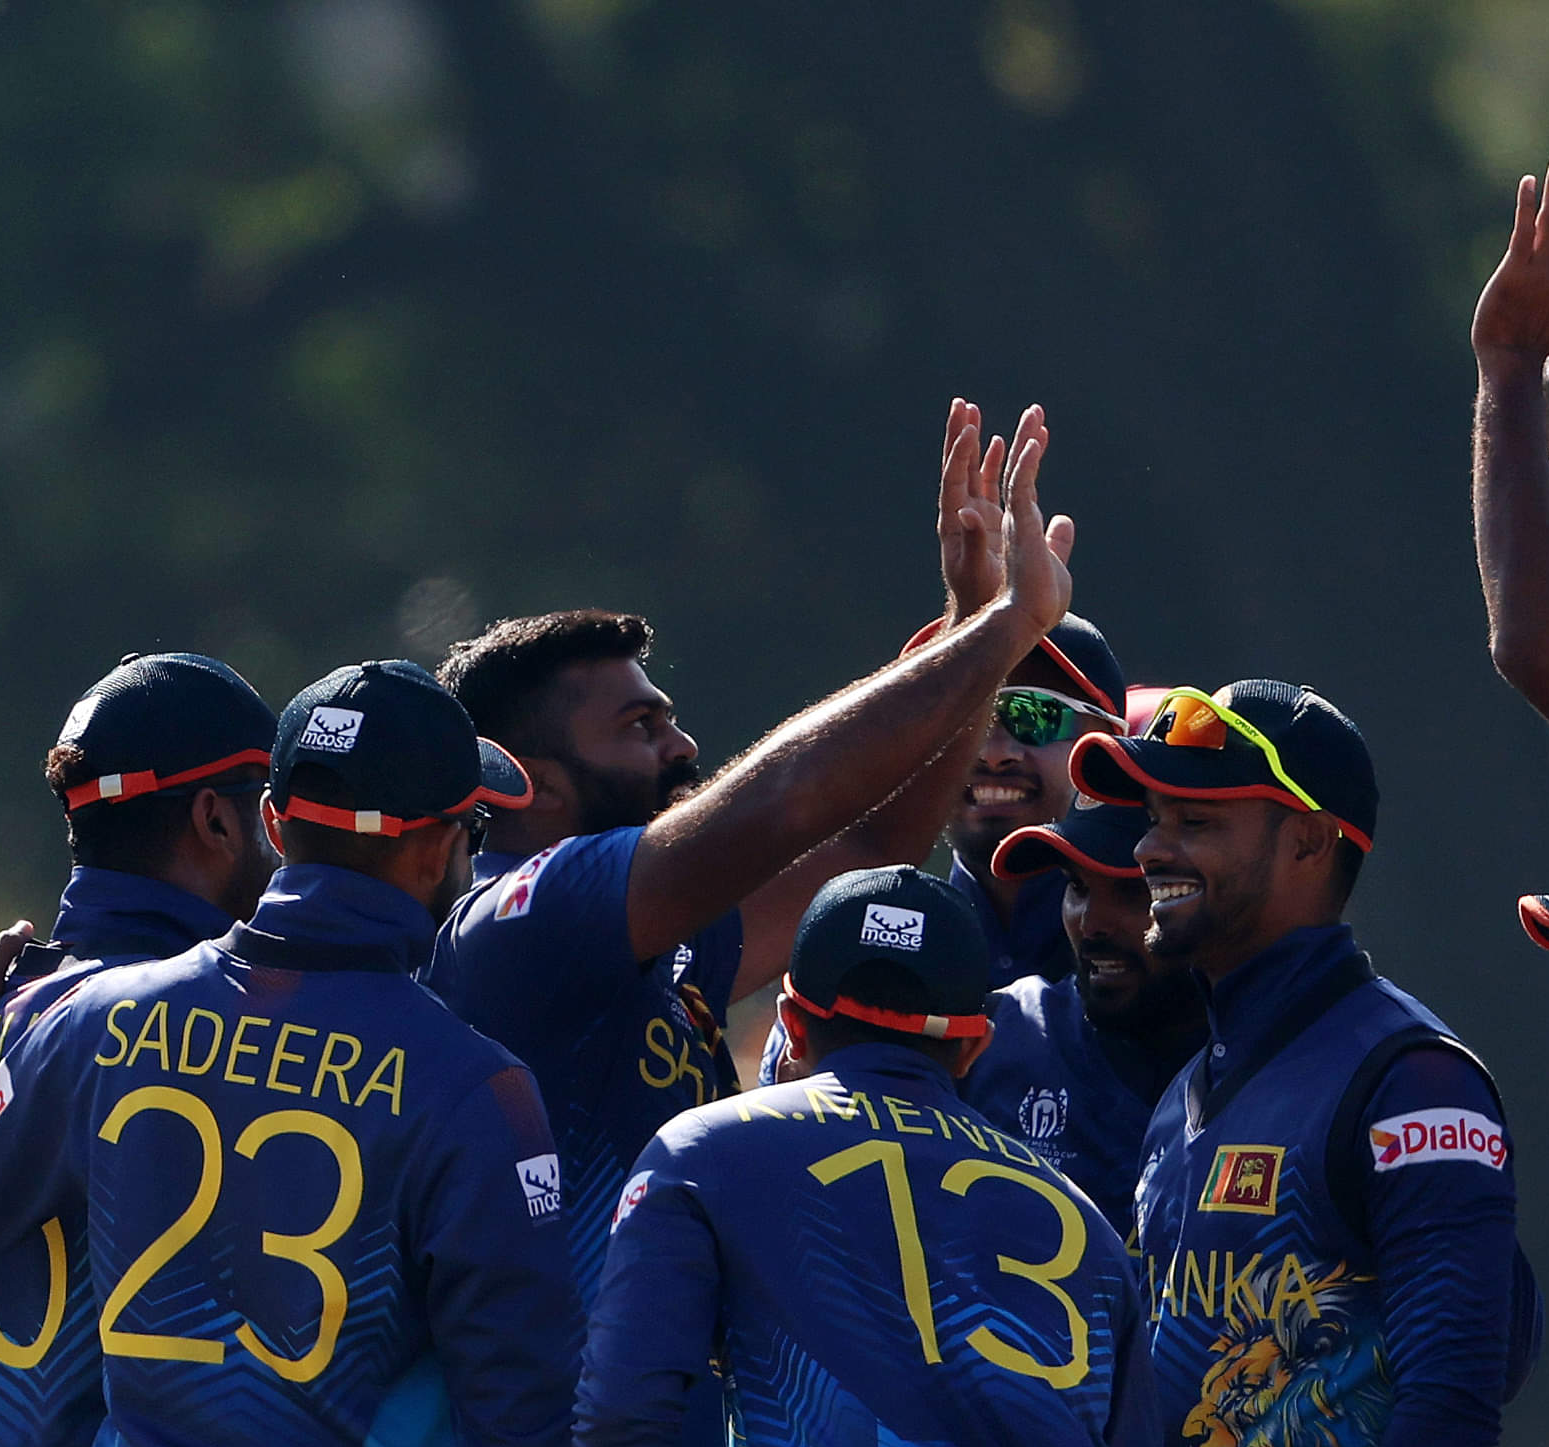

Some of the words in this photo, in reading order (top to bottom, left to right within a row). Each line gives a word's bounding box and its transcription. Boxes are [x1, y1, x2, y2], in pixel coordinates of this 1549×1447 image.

[300, 730, 356, 749] moose
[860, 927, 923, 948] moose
[94, 999, 406, 1117] SADEERA
[1401, 1118, 1507, 1166] Dialog
[97, 1086, 364, 1383] 23
[807, 1139, 1090, 1389] 13
[1148, 1249, 1321, 1322] LANKA
